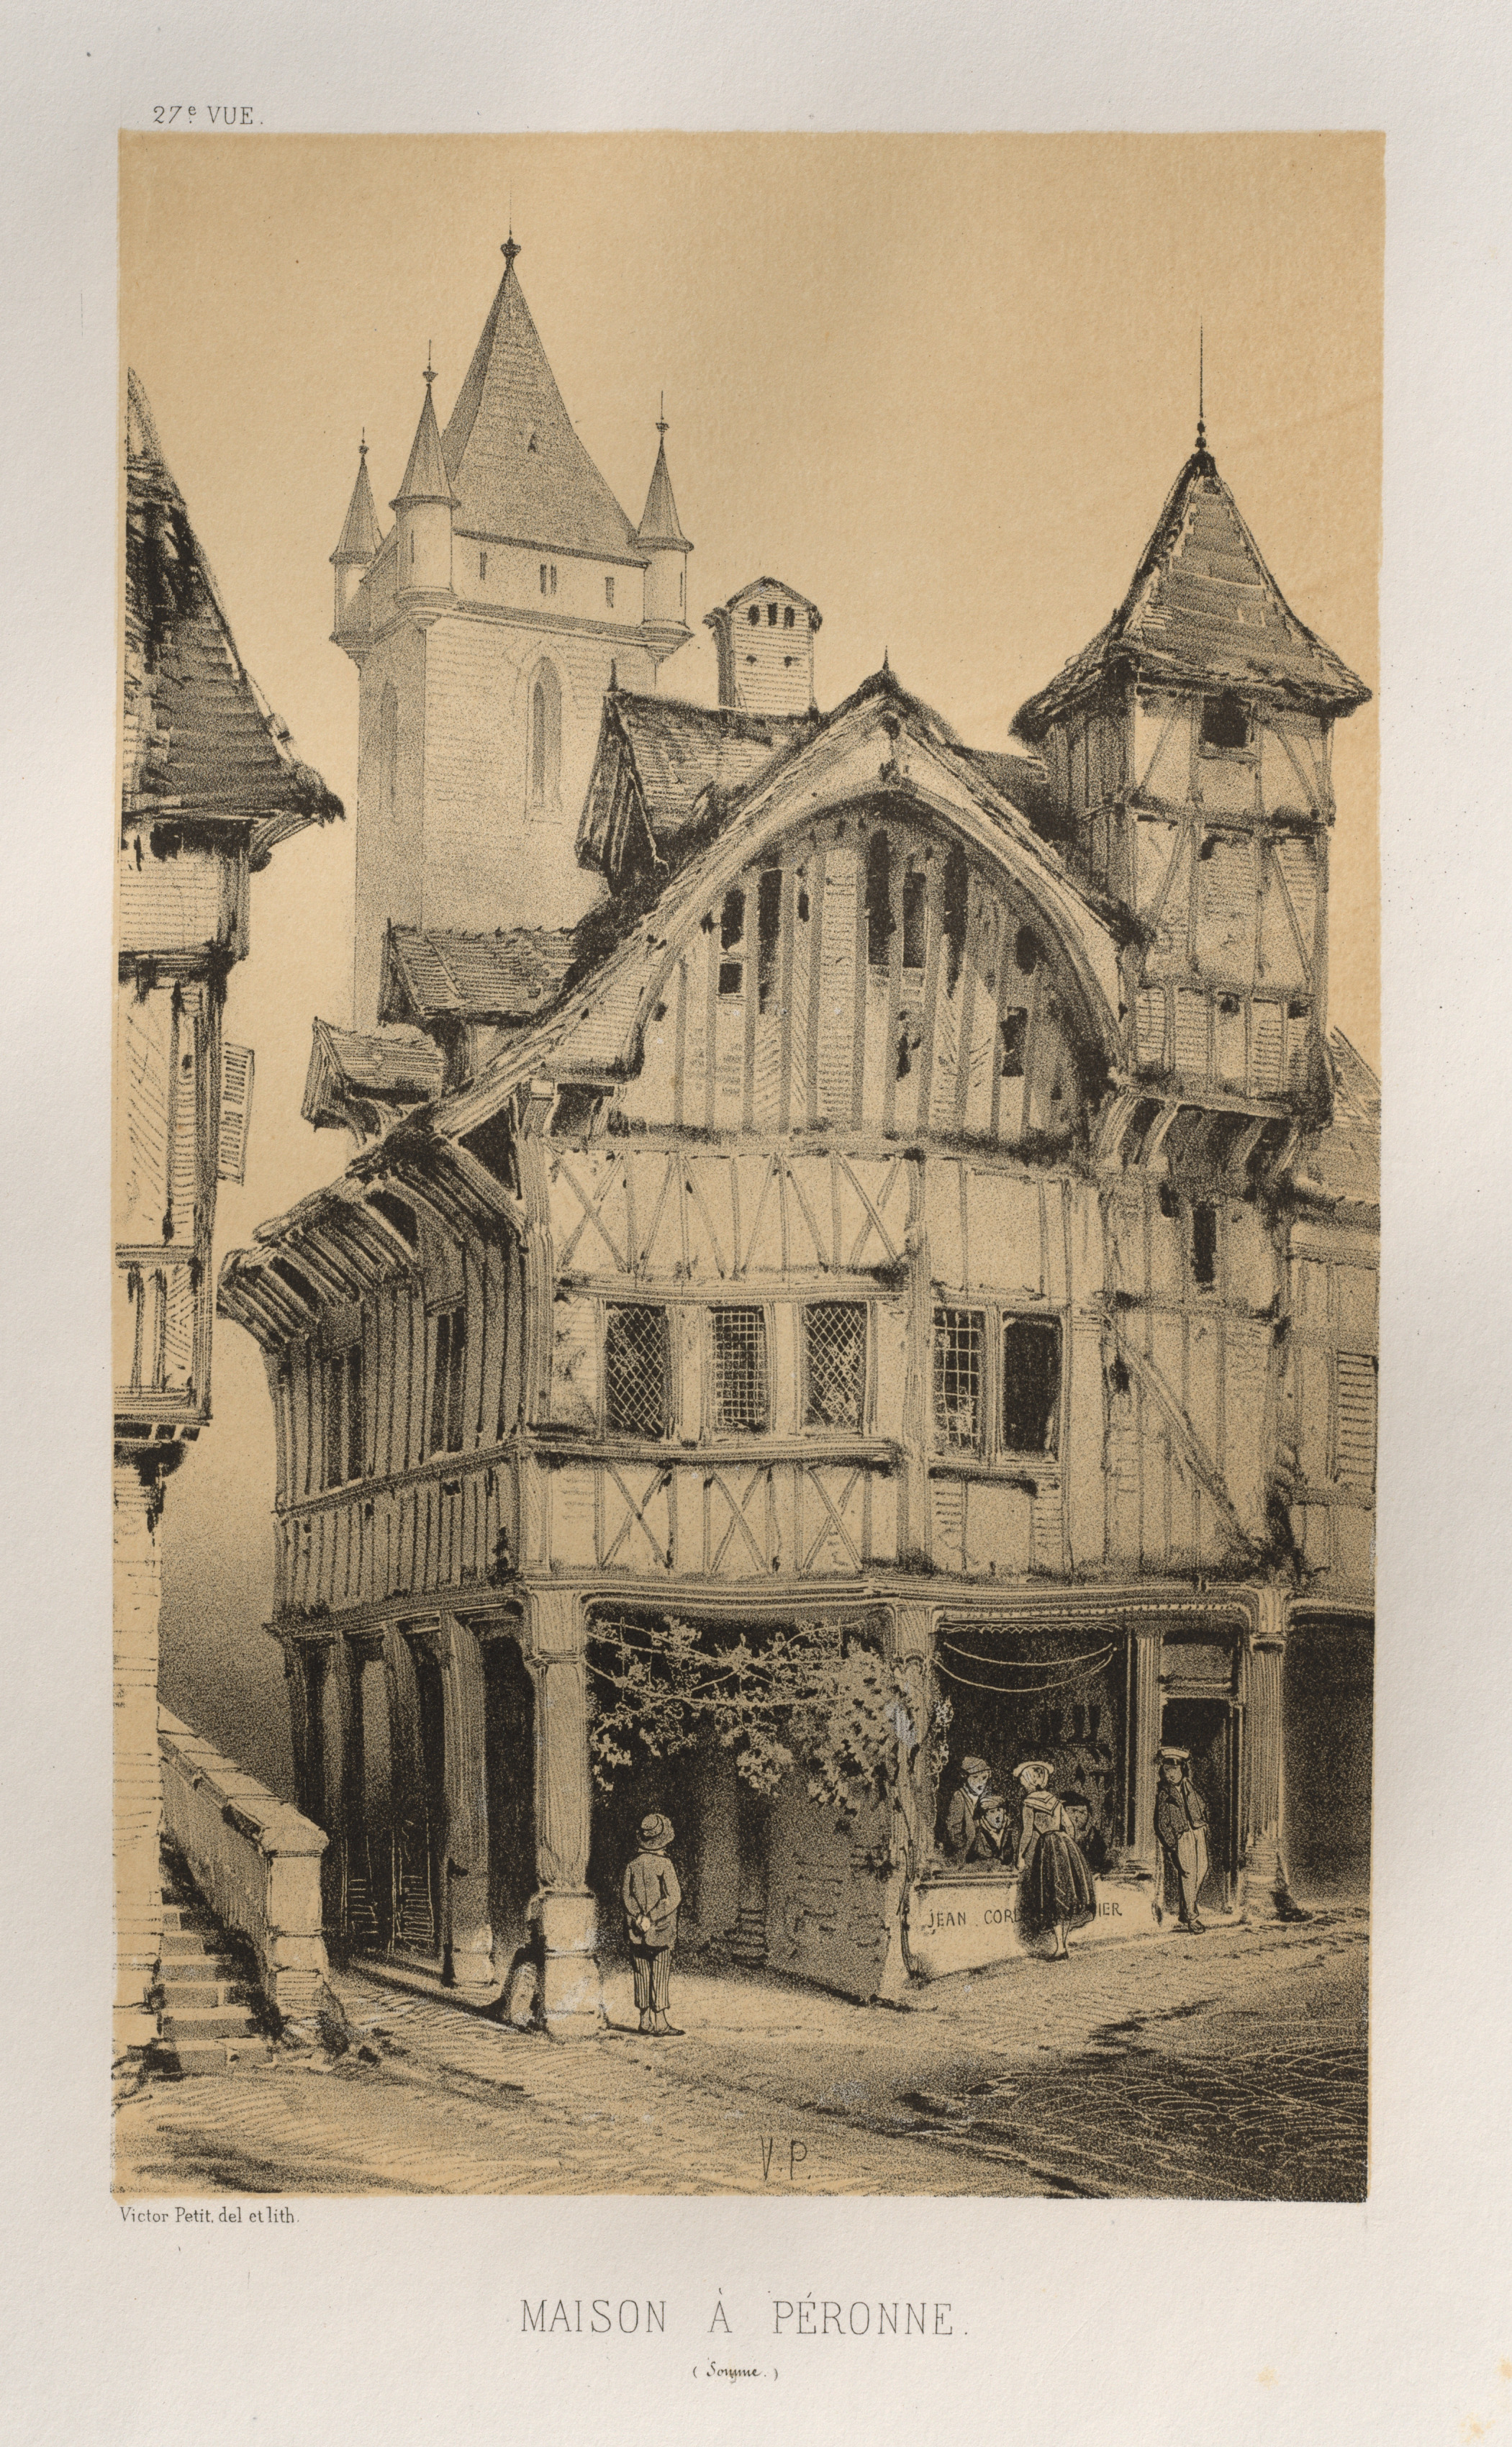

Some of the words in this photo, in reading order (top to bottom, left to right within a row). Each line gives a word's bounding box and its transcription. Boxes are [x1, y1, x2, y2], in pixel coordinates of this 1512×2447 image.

[207, 105, 263, 125] VUE.
[927, 1909, 966, 1928] JEAN
[119, 2206, 169, 2223] Victor
[219, 2206, 243, 2223] del
[249, 2209, 265, 2223] et
[266, 2206, 300, 2224] lith.
[520, 2299, 668, 2334] MAISON
[707, 2287, 733, 2333] À
[771, 2292, 968, 2336] PÉRONNE.
